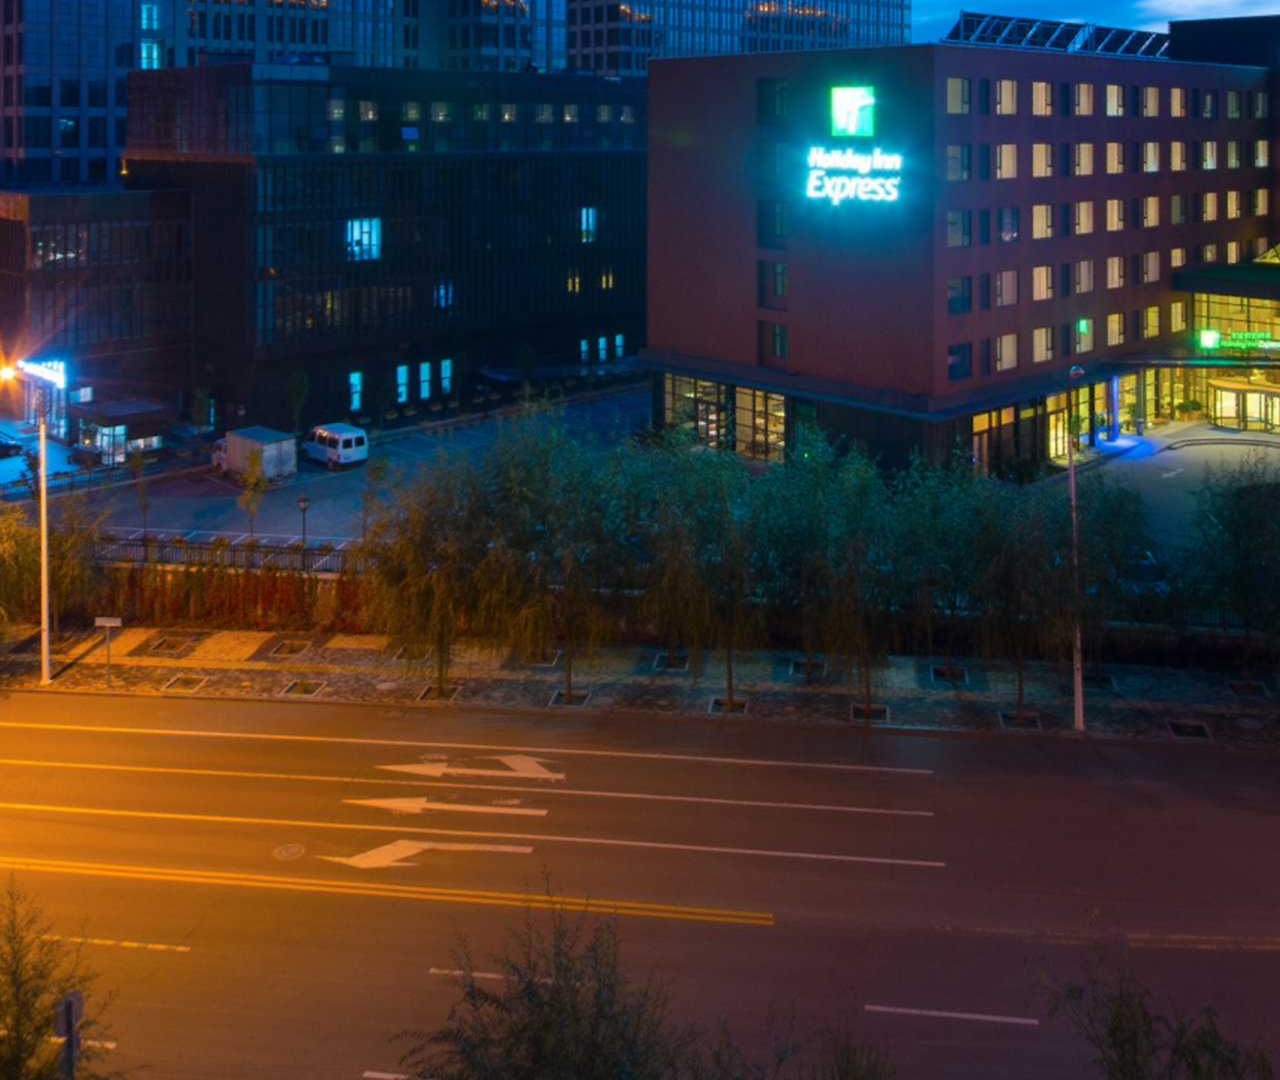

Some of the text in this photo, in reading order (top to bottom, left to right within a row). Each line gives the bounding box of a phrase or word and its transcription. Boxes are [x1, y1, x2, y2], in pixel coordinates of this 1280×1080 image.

[808, 147, 901, 174] Holiday Inn
[806, 170, 899, 205] Express
